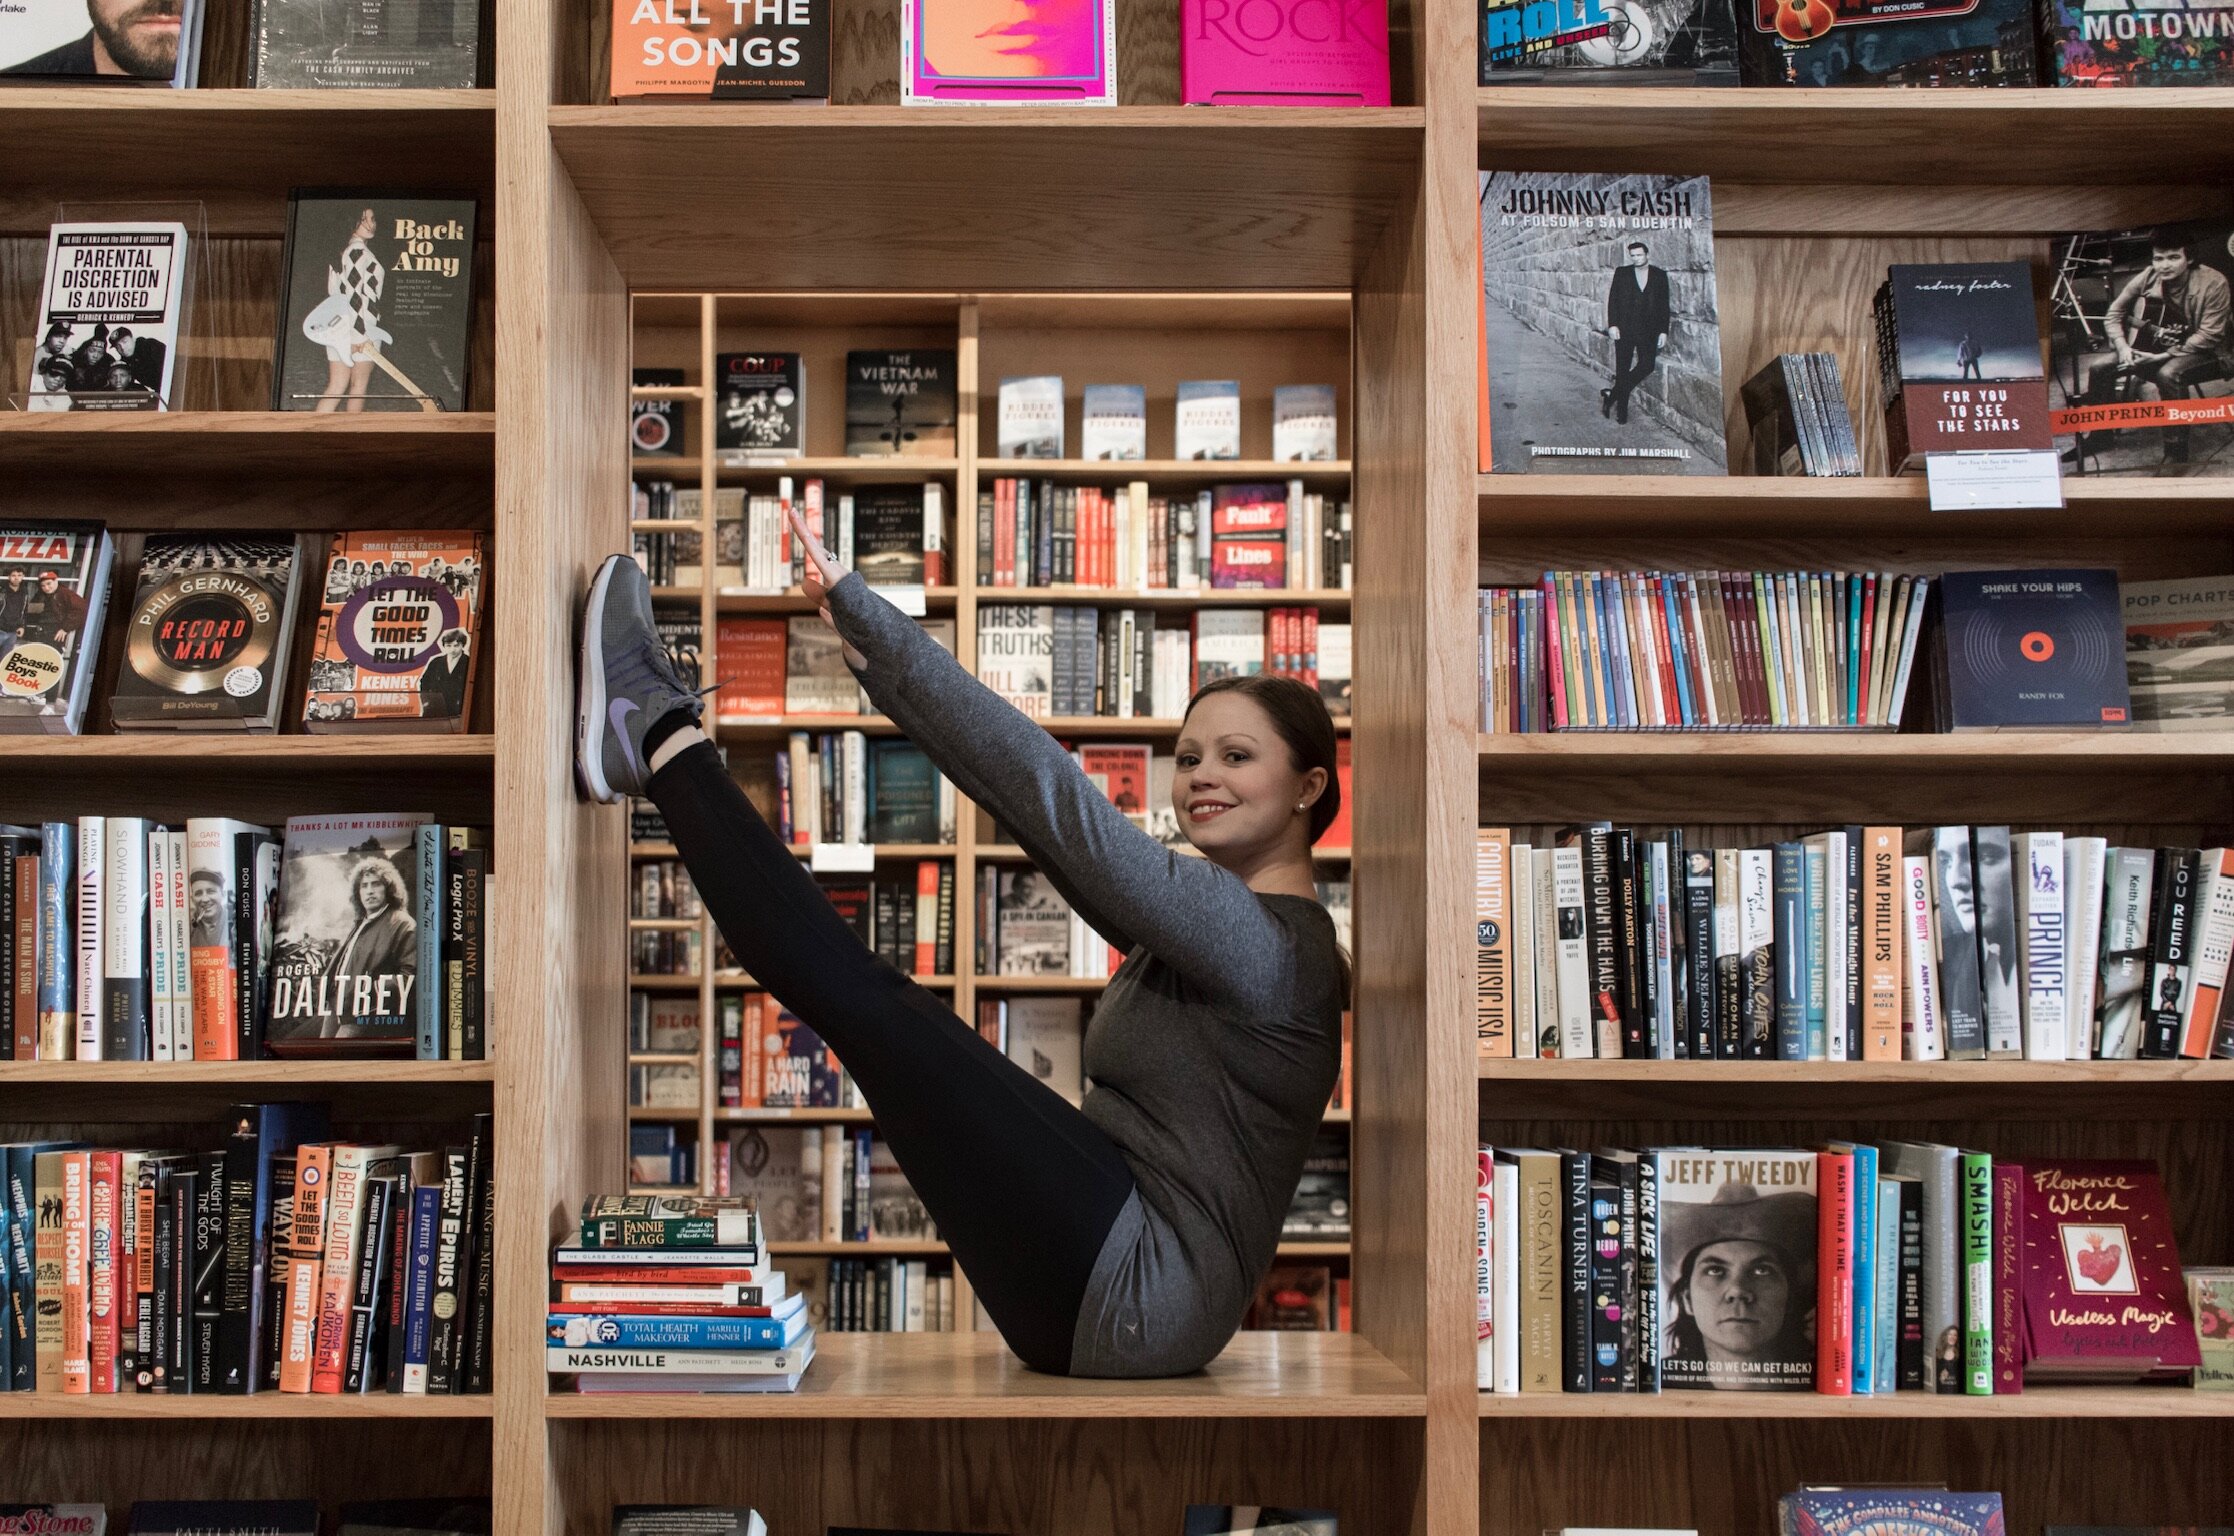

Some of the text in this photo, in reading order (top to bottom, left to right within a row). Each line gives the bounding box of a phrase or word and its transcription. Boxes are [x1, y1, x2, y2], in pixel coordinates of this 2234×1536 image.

[630, 0, 810, 25] ALL THE
[1872, 2, 1925, 13] BY DON CUSIC
[1487, 0, 1610, 49] ROLL
[2083, 12, 2234, 41] MOTOWN
[642, 37, 801, 67] SONGS
[306, 66, 415, 75] THE CASH FAMILY ARCHIVES
[1500, 188, 1692, 217] JOHNNY CASH
[394, 219, 464, 240] Back
[74, 249, 153, 268] PARENTAL
[407, 238, 434, 256] to
[391, 252, 459, 278] Amy
[62, 270, 160, 288] DISCRETION
[68, 290, 149, 308] IS ADVISED
[729, 358, 785, 374] COUP
[888, 354, 911, 365] THE
[860, 367, 938, 380] VIETNAM
[879, 382, 919, 395] WAR
[1944, 390, 2007, 403] FOR YOU
[1950, 404, 2003, 417] TO SEE
[2060, 411, 2105, 425] JOHN
[2109, 405, 2165, 421] PRINE
[2167, 406, 2226, 422] Beyond
[1937, 419, 2020, 432] THE STARS
[1226, 507, 1273, 526] Fault
[391, 551, 428, 559] THE WHO
[1226, 548, 1272, 565] Lines
[1982, 582, 2082, 594] SHAKE YOUR HIPS
[160, 620, 246, 639] RECORD
[980, 606, 1039, 629] THESE
[174, 641, 225, 660] MAN
[978, 632, 1052, 656] TRUTHS
[4, 661, 38, 678] Boys
[10, 652, 60, 675] Beastie
[6, 672, 41, 690] Book
[361, 676, 419, 689] KENNEY
[162, 701, 218, 711] Bill DeYoung
[3, 844, 11, 889] JOHNNY
[115, 830, 128, 915] SLOWHAND
[242, 867, 250, 918] DON CUSIC
[1912, 867, 1928, 941] GOOD BOOTY
[3, 893, 11, 922] CASH
[452, 874, 463, 941] Logic Pro X
[1623, 879, 1635, 946] DOLLY PARTON
[1875, 853, 1891, 962] SAM PHILLIPS
[2125, 875, 2140, 949] Keith Richards
[466, 869, 477, 977] BOOZE VINYL
[3, 934, 11, 985] FOREVER
[21, 917, 32, 995] THE MAN IN SONG
[2028, 912, 2063, 997] PRINCE
[83, 953, 93, 1011] Nate Chinen
[277, 965, 319, 977] ROGER
[1699, 918, 1710, 1029] WILLIE NELSON
[1730, 955, 1738, 988] DUST
[243, 942, 251, 1036] Elvis and Nashville
[272, 975, 416, 1019] DALTREY
[1921, 964, 1933, 1033] ANN POWERS
[450, 972, 463, 1031] DUMMIES
[1730, 993, 1738, 1040] WOMAN
[777, 1055, 810, 1072] HARD
[766, 1071, 811, 1095] RAIN
[1664, 1160, 1811, 1185] JEFF TWEEDY
[2032, 1170, 2140, 1192] Florence
[1968, 1166, 1989, 1257] SMASH!
[2048, 1192, 2129, 1215] Welch
[65, 1162, 80, 1286] BRING HOME
[623, 1220, 665, 1233] FANNIE
[1572, 1160, 1587, 1293] TINA TURNER
[1623, 1188, 1635, 1249] JOHN PRINE
[161, 1219, 170, 1269] SHE BEGAT
[623, 1233, 665, 1245] FLAGG
[391, 1209, 406, 1326] THE MAKING OF JOHN LENNON
[139, 1299, 152, 1353] MERLE HAGGARD
[156, 1289, 166, 1359] JOAN MORGAN
[332, 1312, 343, 1350] JORMA
[623, 1323, 698, 1333] TOTAL HEALTH
[707, 1325, 740, 1334] MARILU
[2049, 1306, 2176, 1334] Useless Magic
[634, 1333, 690, 1343] MAKEOVER
[707, 1333, 740, 1341] HENNER
[201, 1322, 212, 1385] STEVEN HYDEN
[568, 1355, 666, 1367] NASHVILLE
[1662, 1360, 1812, 1374] LET'S GO (SO WE CAN GET BACK)
[1823, 1515, 1851, 1536] THE
[1852, 1507, 1910, 1523] COMPLETE
[1912, 1510, 1978, 1536] ANNOTATED
